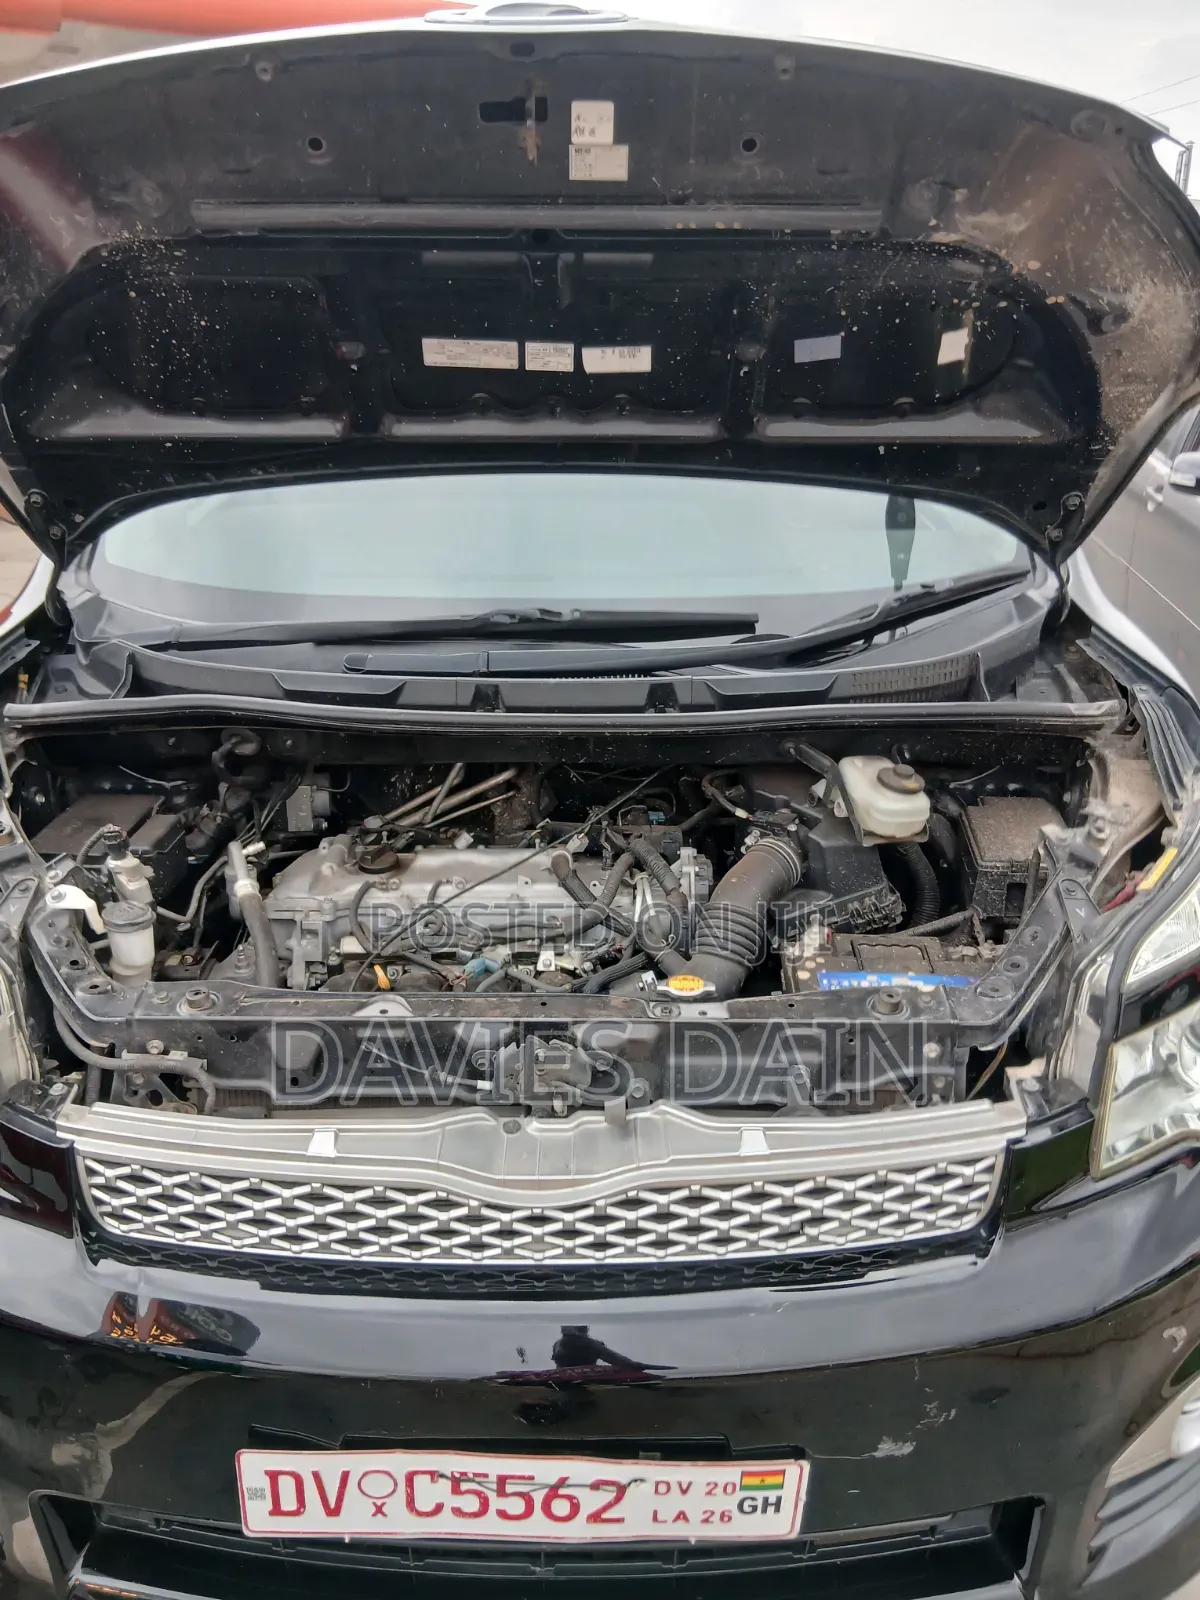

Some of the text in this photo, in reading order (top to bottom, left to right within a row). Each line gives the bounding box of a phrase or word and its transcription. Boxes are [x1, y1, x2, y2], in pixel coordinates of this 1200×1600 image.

[264, 1469, 350, 1517] DV
[404, 1469, 627, 1524] C5562
[654, 1480, 737, 1497] DV 20
[736, 1495, 782, 1515] GH
[651, 1509, 733, 1524] LA 26
